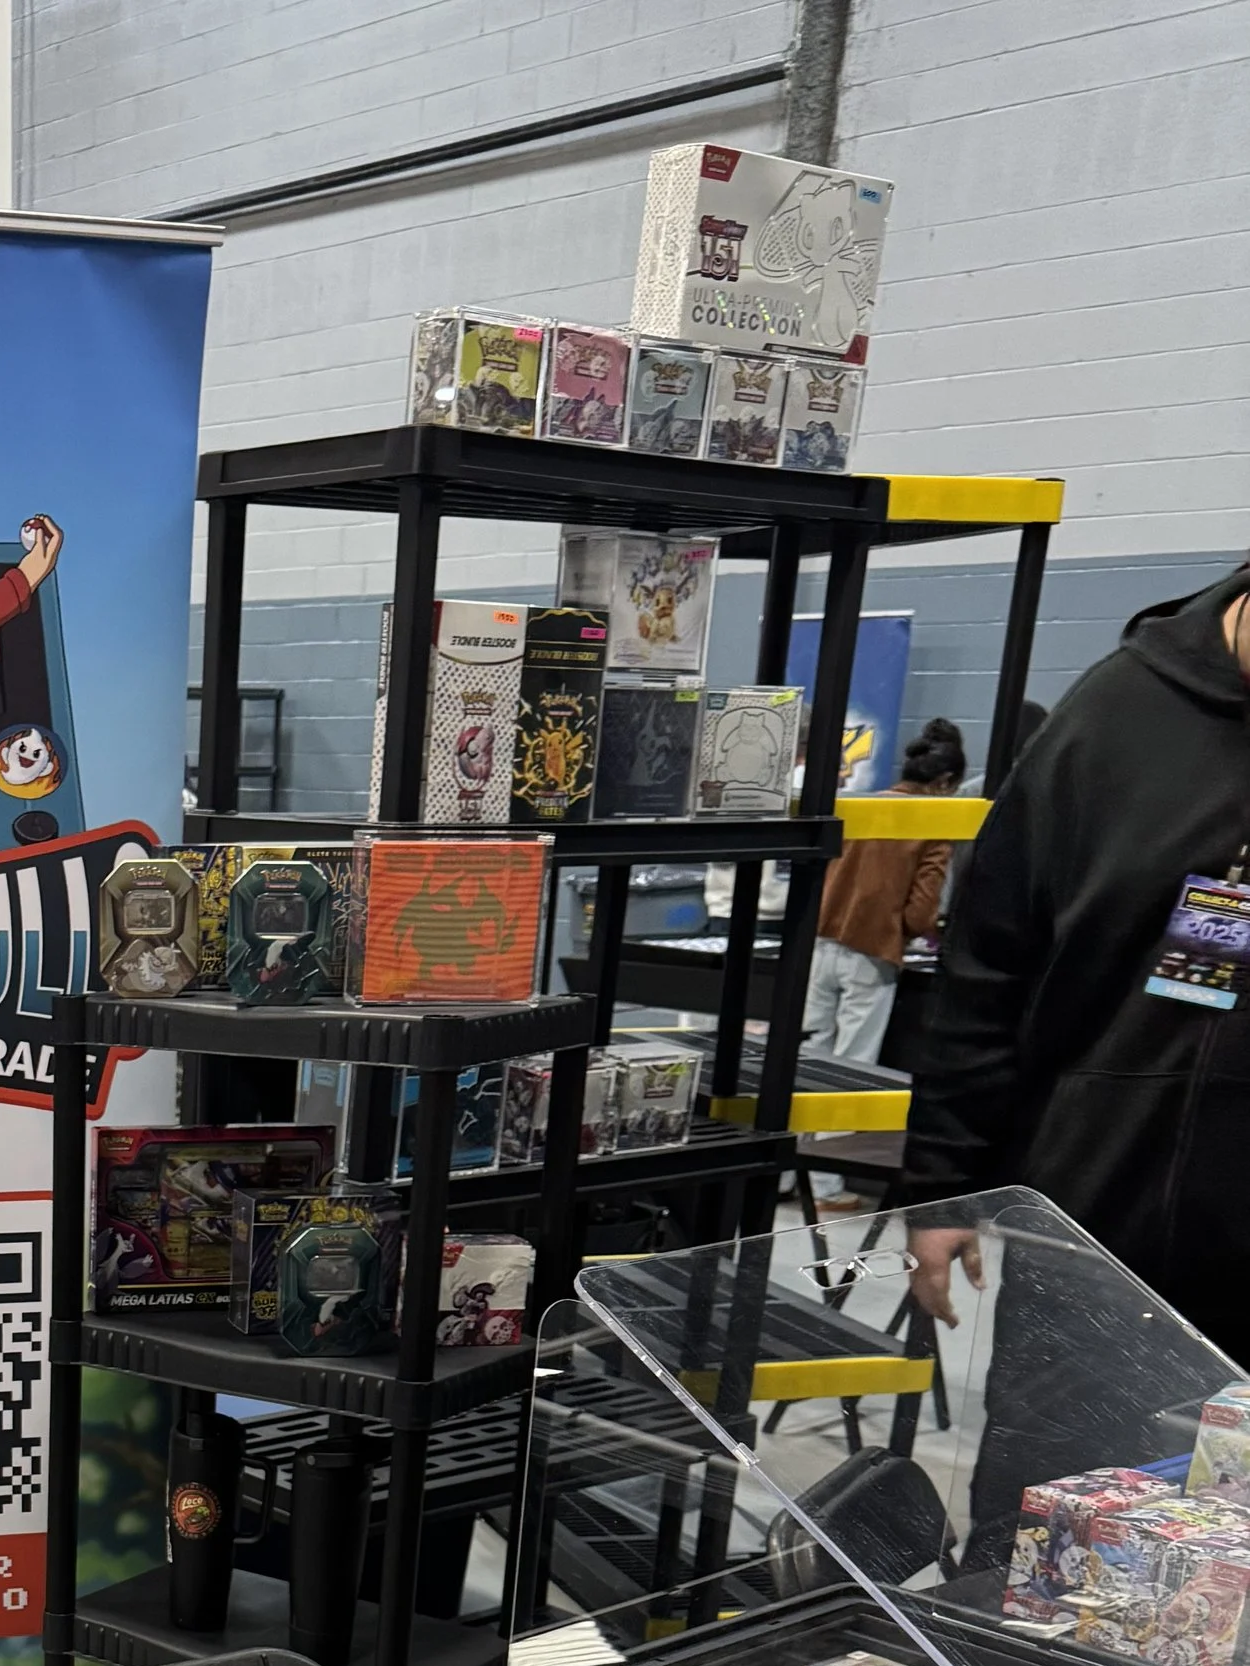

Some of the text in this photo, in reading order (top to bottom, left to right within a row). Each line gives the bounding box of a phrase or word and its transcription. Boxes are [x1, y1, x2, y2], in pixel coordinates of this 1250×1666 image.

[701, 232, 741, 282] 151
[692, 306, 802, 336] COLLECTION
[111, 1294, 148, 1307] MEGA
[149, 1293, 194, 1306] LATIAS
[181, 1496, 204, 1510] Loco
